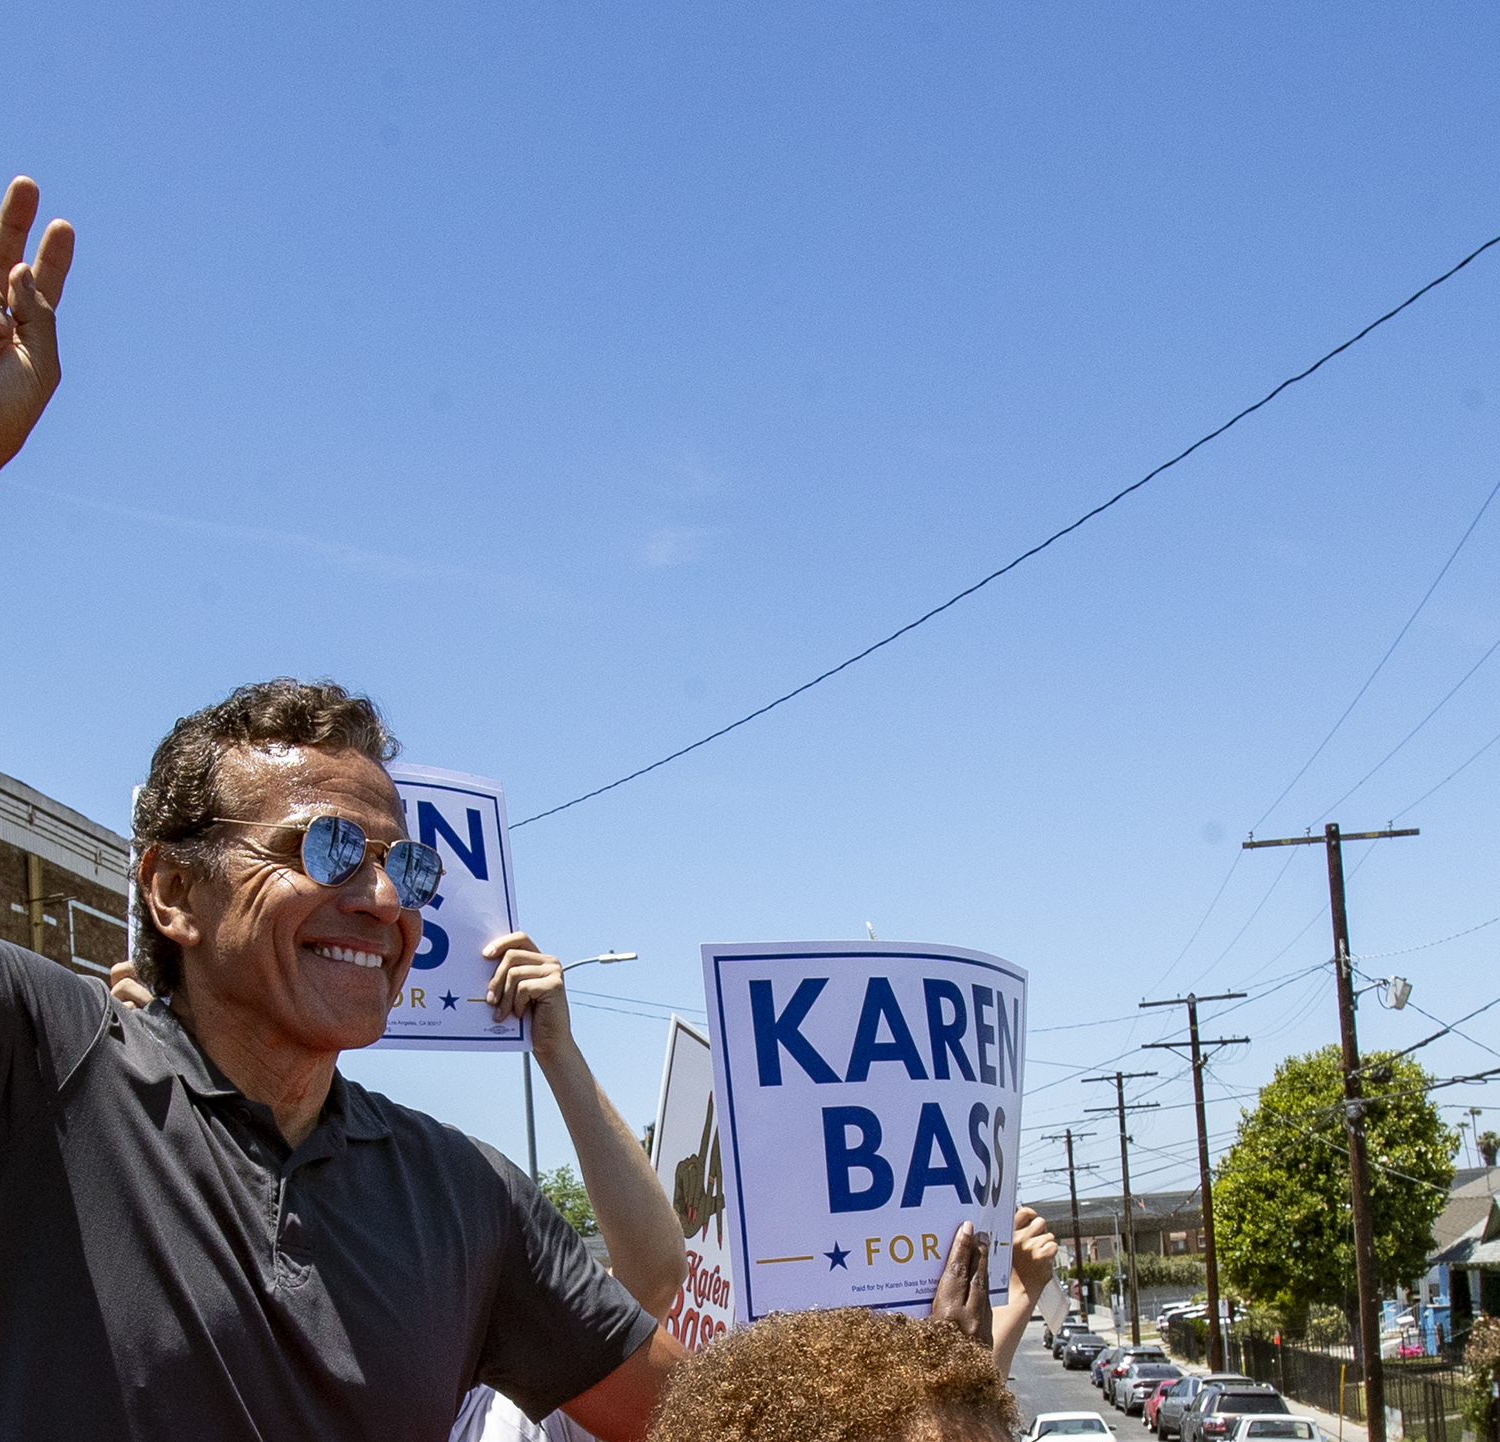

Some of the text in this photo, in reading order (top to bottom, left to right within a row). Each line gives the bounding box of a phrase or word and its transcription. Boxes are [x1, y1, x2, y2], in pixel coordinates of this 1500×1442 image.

[748, 977, 1020, 1094] KAREN
[822, 1102, 1007, 1213] BASS
[865, 1233, 942, 1266] FOR
[686, 1250, 730, 1310] Karen
[876, 1283, 884, 1292] by
[885, 1281, 902, 1289] Karen
[904, 1280, 918, 1288] Bass
